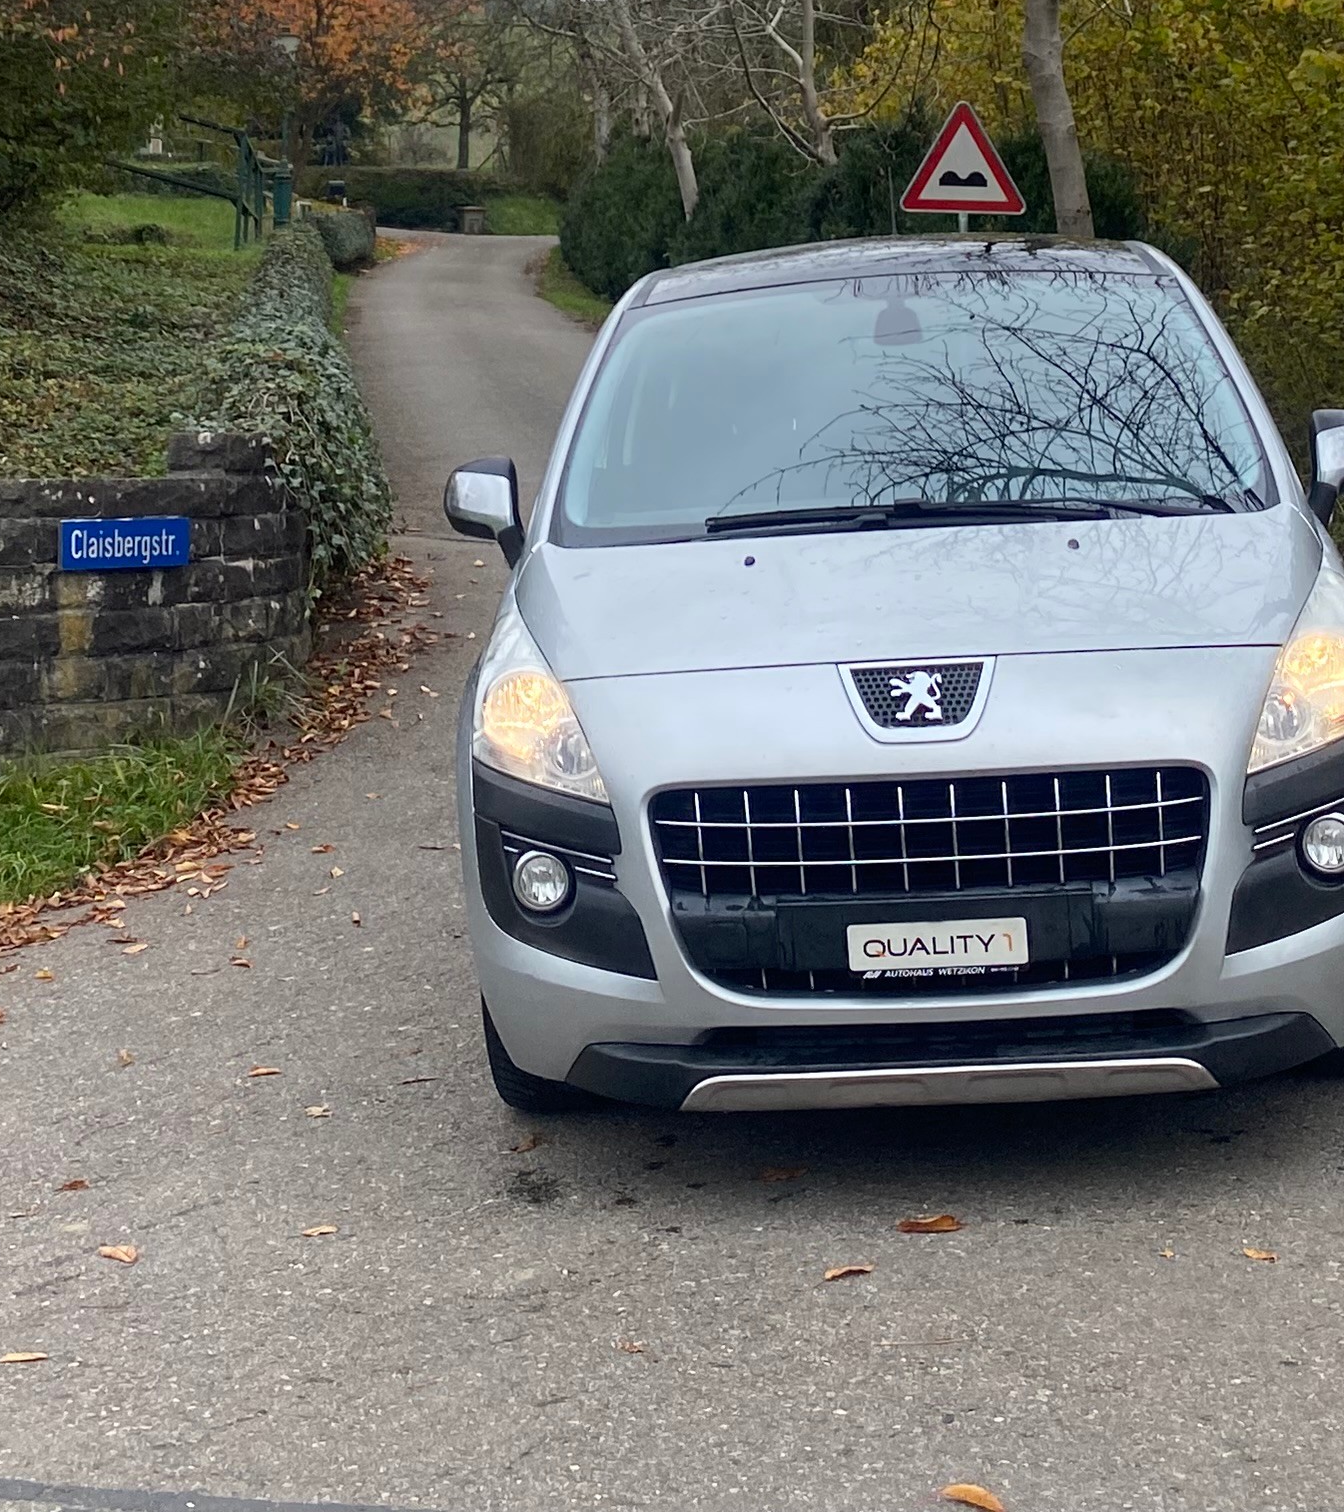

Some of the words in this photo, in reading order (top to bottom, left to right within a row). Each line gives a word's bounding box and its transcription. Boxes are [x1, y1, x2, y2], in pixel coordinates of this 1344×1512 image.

[71, 528, 180, 564] Claisbergstr.
[884, 968, 934, 978] AUTOHAUS
[938, 966, 986, 976] WETZIKON
